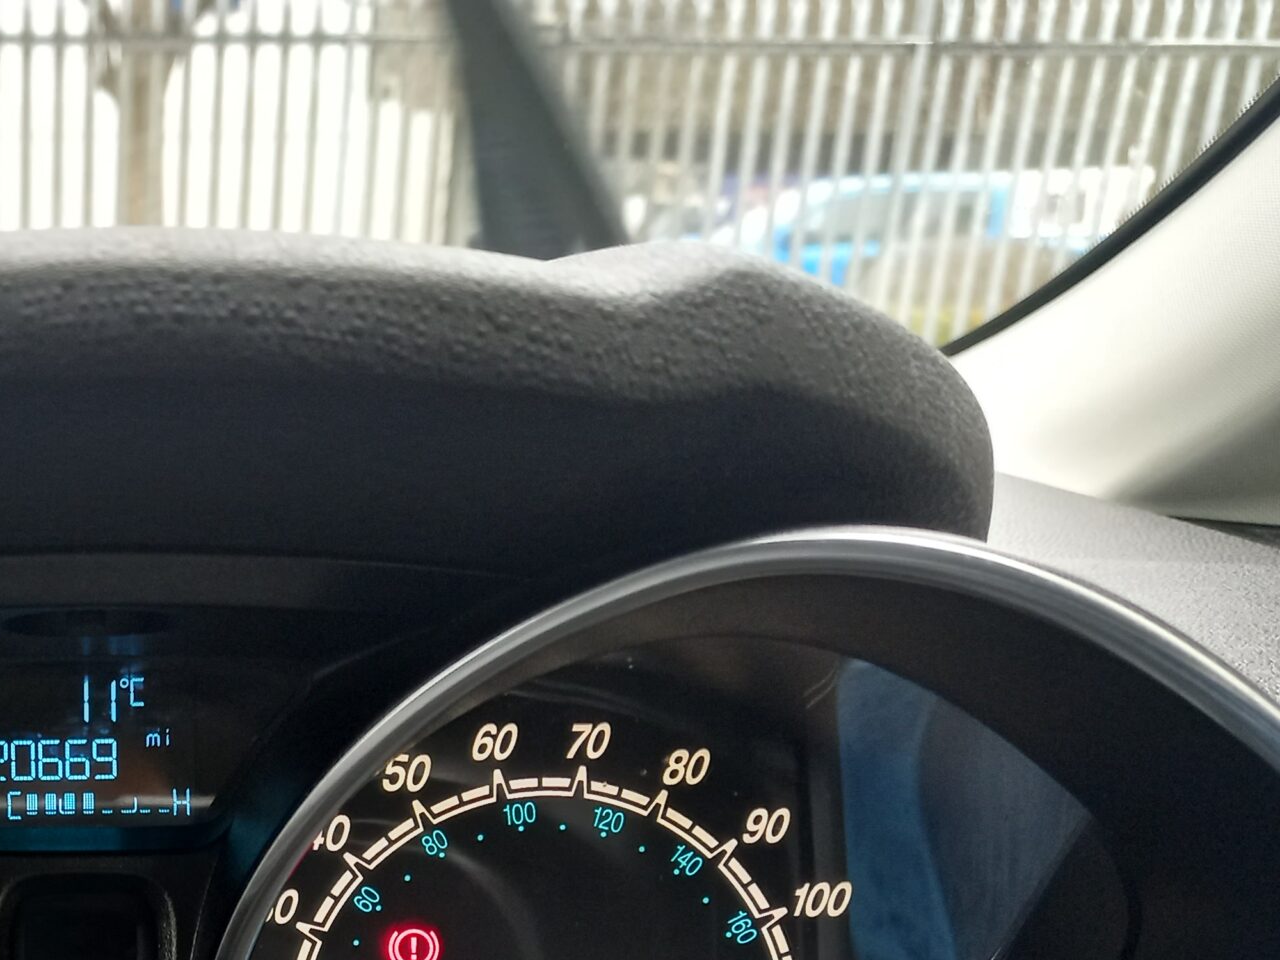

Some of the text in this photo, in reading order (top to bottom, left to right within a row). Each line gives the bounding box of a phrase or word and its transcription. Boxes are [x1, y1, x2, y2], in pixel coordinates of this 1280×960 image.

[146, 728, 170, 748] mi
[472, 722, 518, 761] 60
[566, 722, 611, 760] 70
[382, 753, 432, 793] 50
[662, 748, 710, 786] 80
[503, 801, 536, 826] 100
[594, 806, 624, 833] 120
[743, 807, 790, 844] 90
[421, 829, 448, 855] 80
[670, 844, 702, 876] 140
[265, 888, 299, 924] 0
[354, 886, 380, 912] 60
[793, 881, 852, 917] 100
[726, 910, 757, 944] 160
